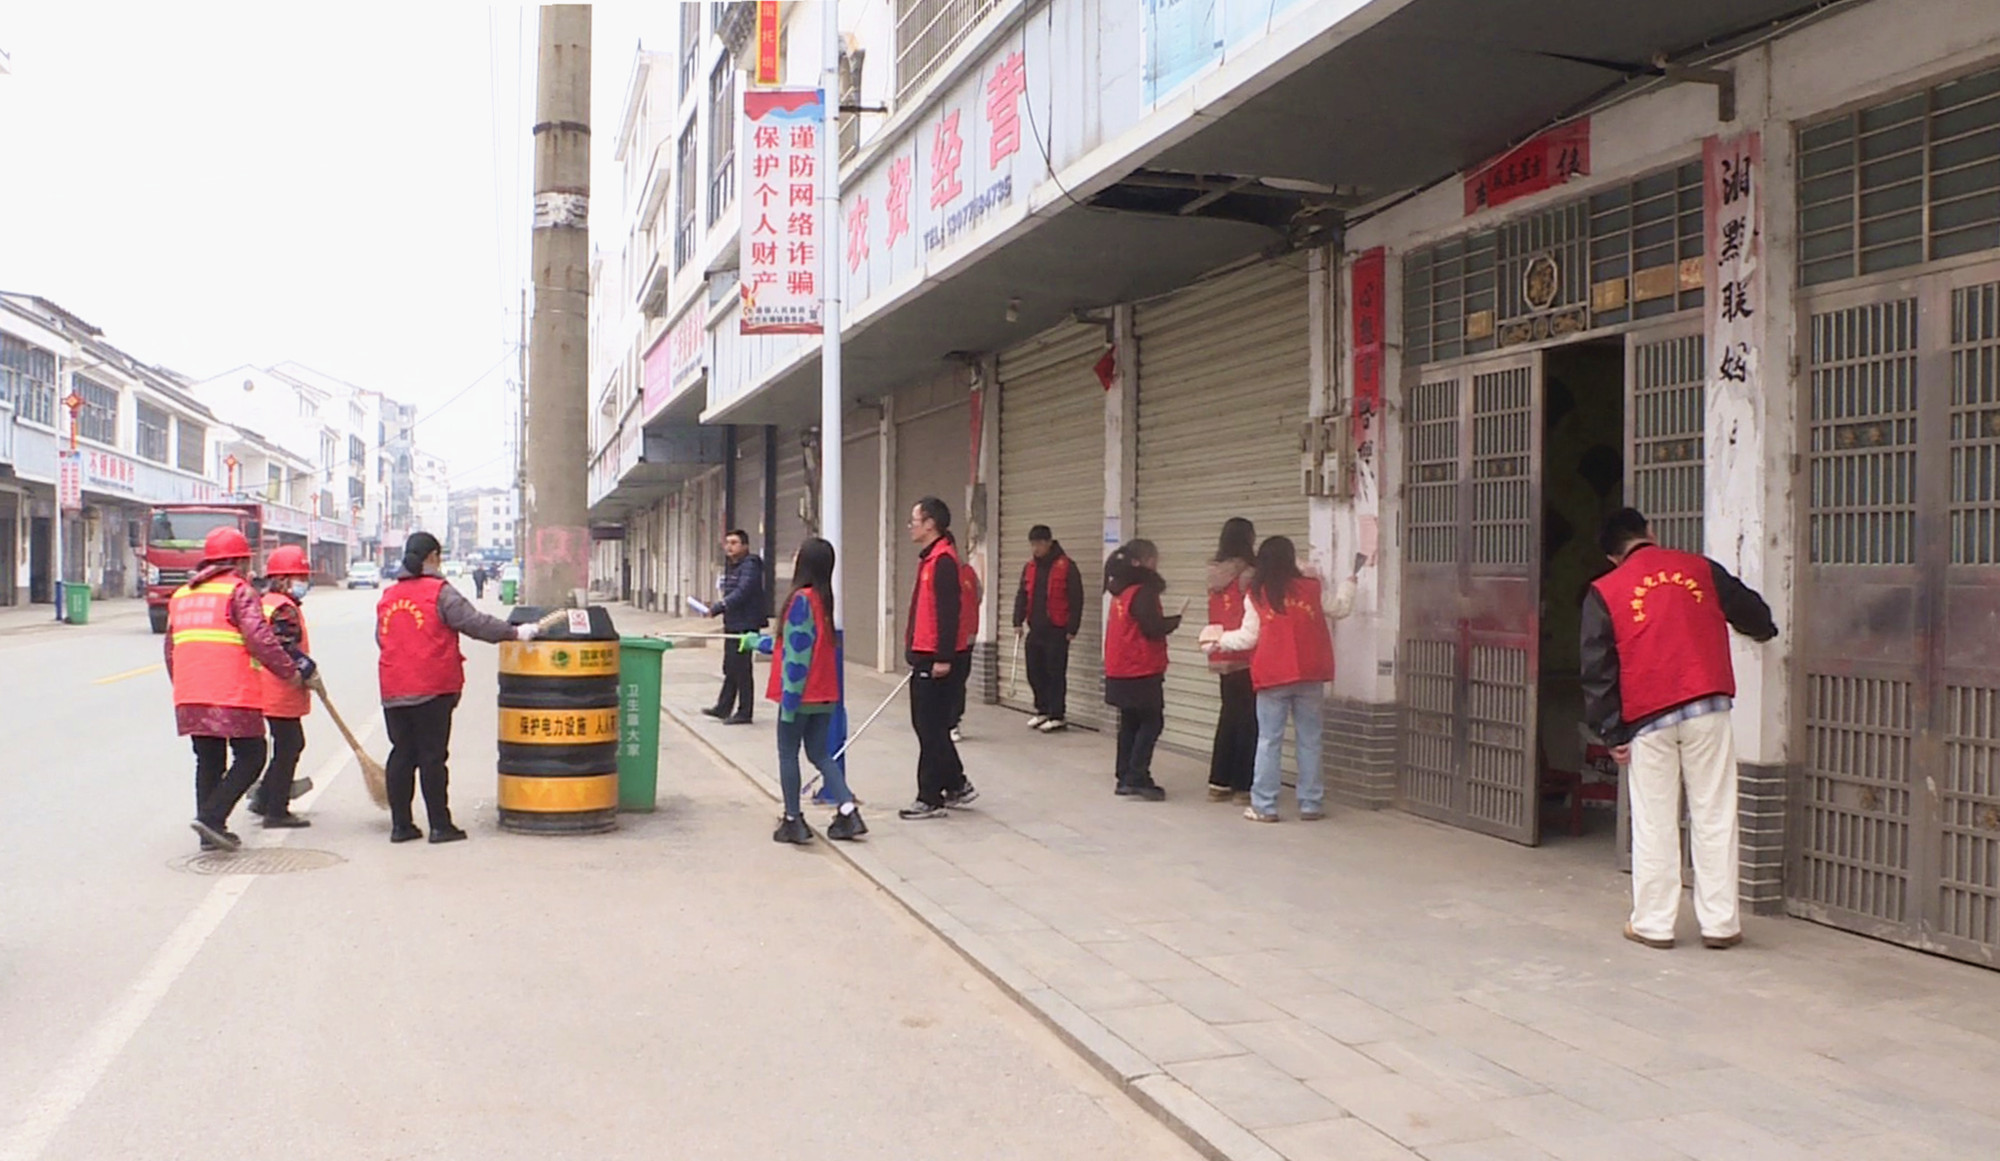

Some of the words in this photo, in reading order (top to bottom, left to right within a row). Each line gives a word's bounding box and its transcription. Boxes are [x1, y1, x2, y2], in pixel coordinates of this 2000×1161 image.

[751, 124, 780, 295] 保护个人财产
[786, 124, 815, 296] 谨防网络诈骗
[847, 50, 1026, 273] 农资经营
[520, 715, 587, 737] 保护电力设施
